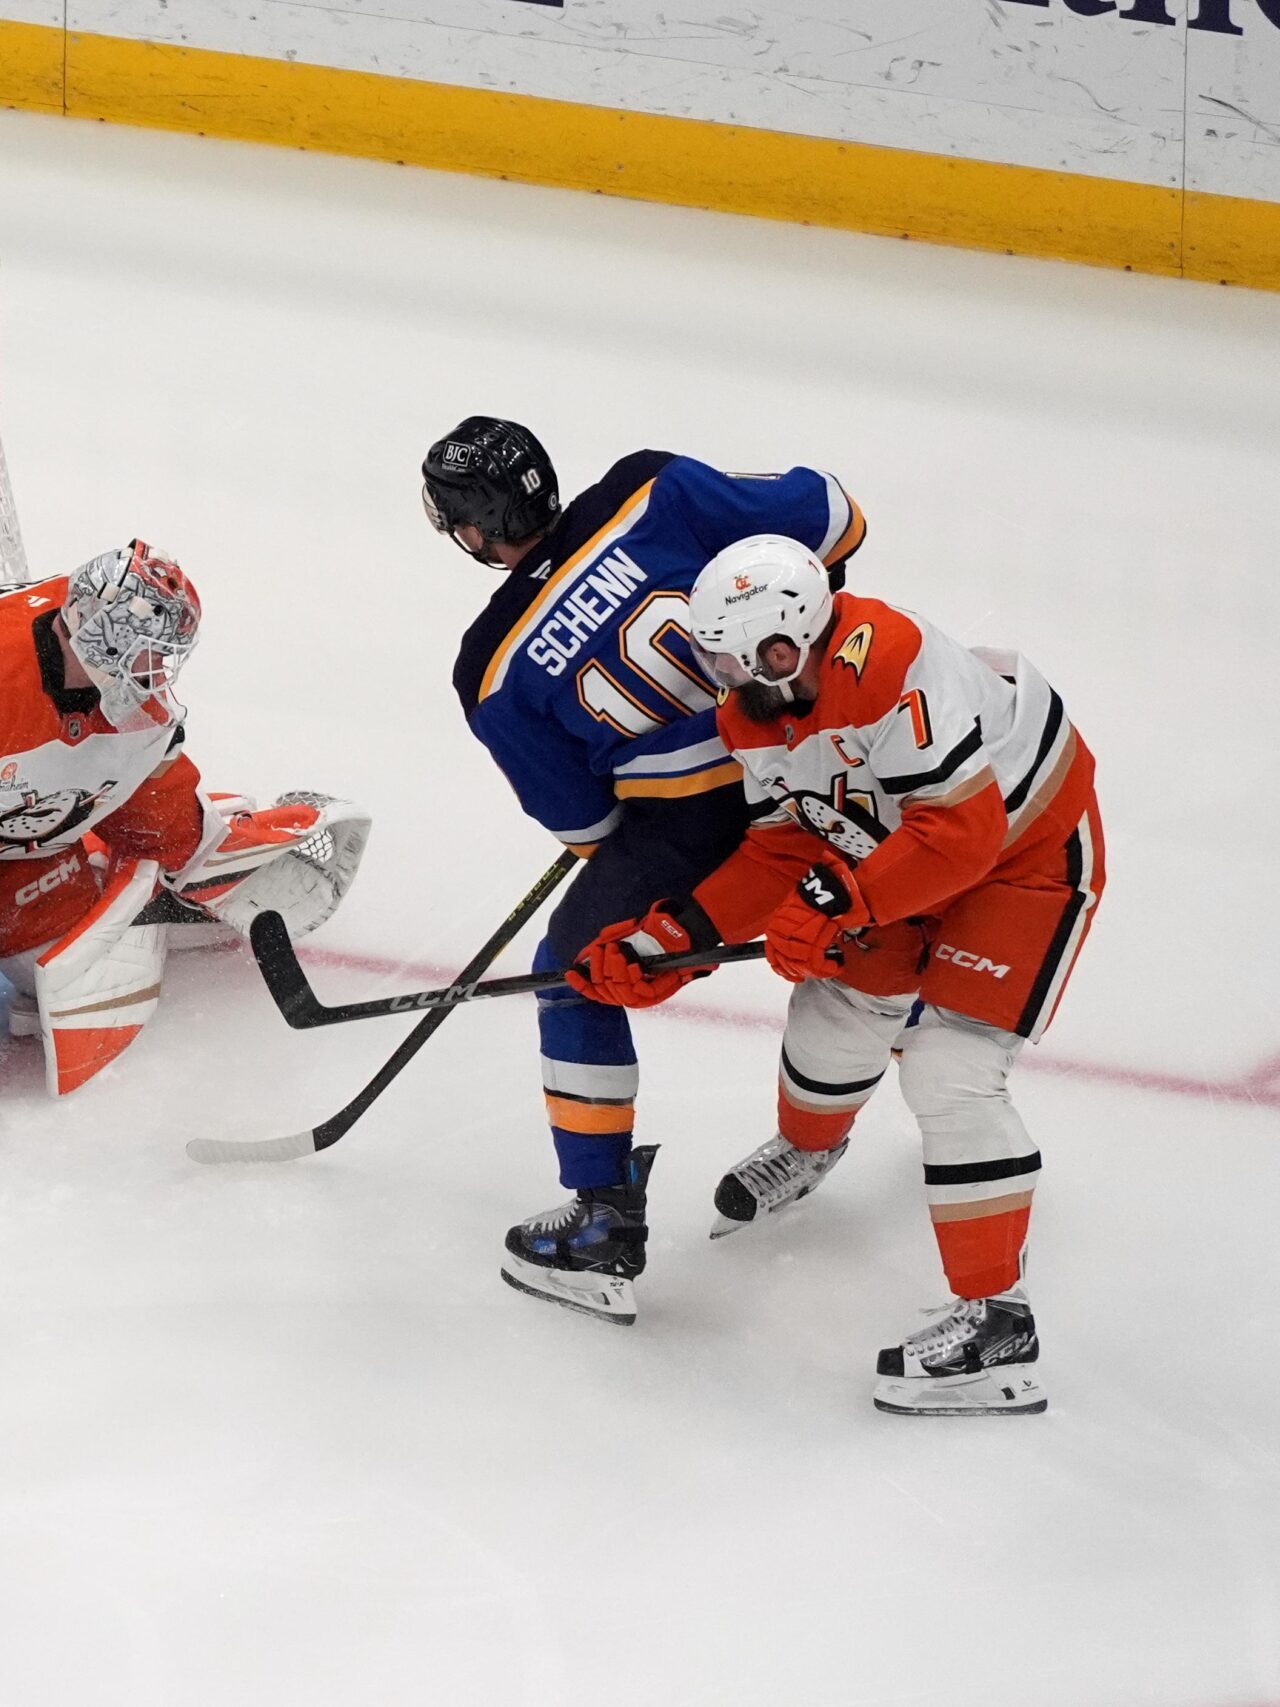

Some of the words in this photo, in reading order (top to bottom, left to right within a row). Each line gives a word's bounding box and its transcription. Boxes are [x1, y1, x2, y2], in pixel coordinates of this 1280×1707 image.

[445, 445, 468, 463] BJC
[521, 468, 541, 494] 10
[527, 547, 648, 676] SCHENN
[725, 584, 768, 606] Navigator
[576, 590, 722, 738] 10
[897, 688, 933, 750] 7
[830, 734, 865, 767] C
[15, 855, 81, 905] CCM
[935, 943, 1011, 978] CCM
[389, 981, 481, 1011] CCM
